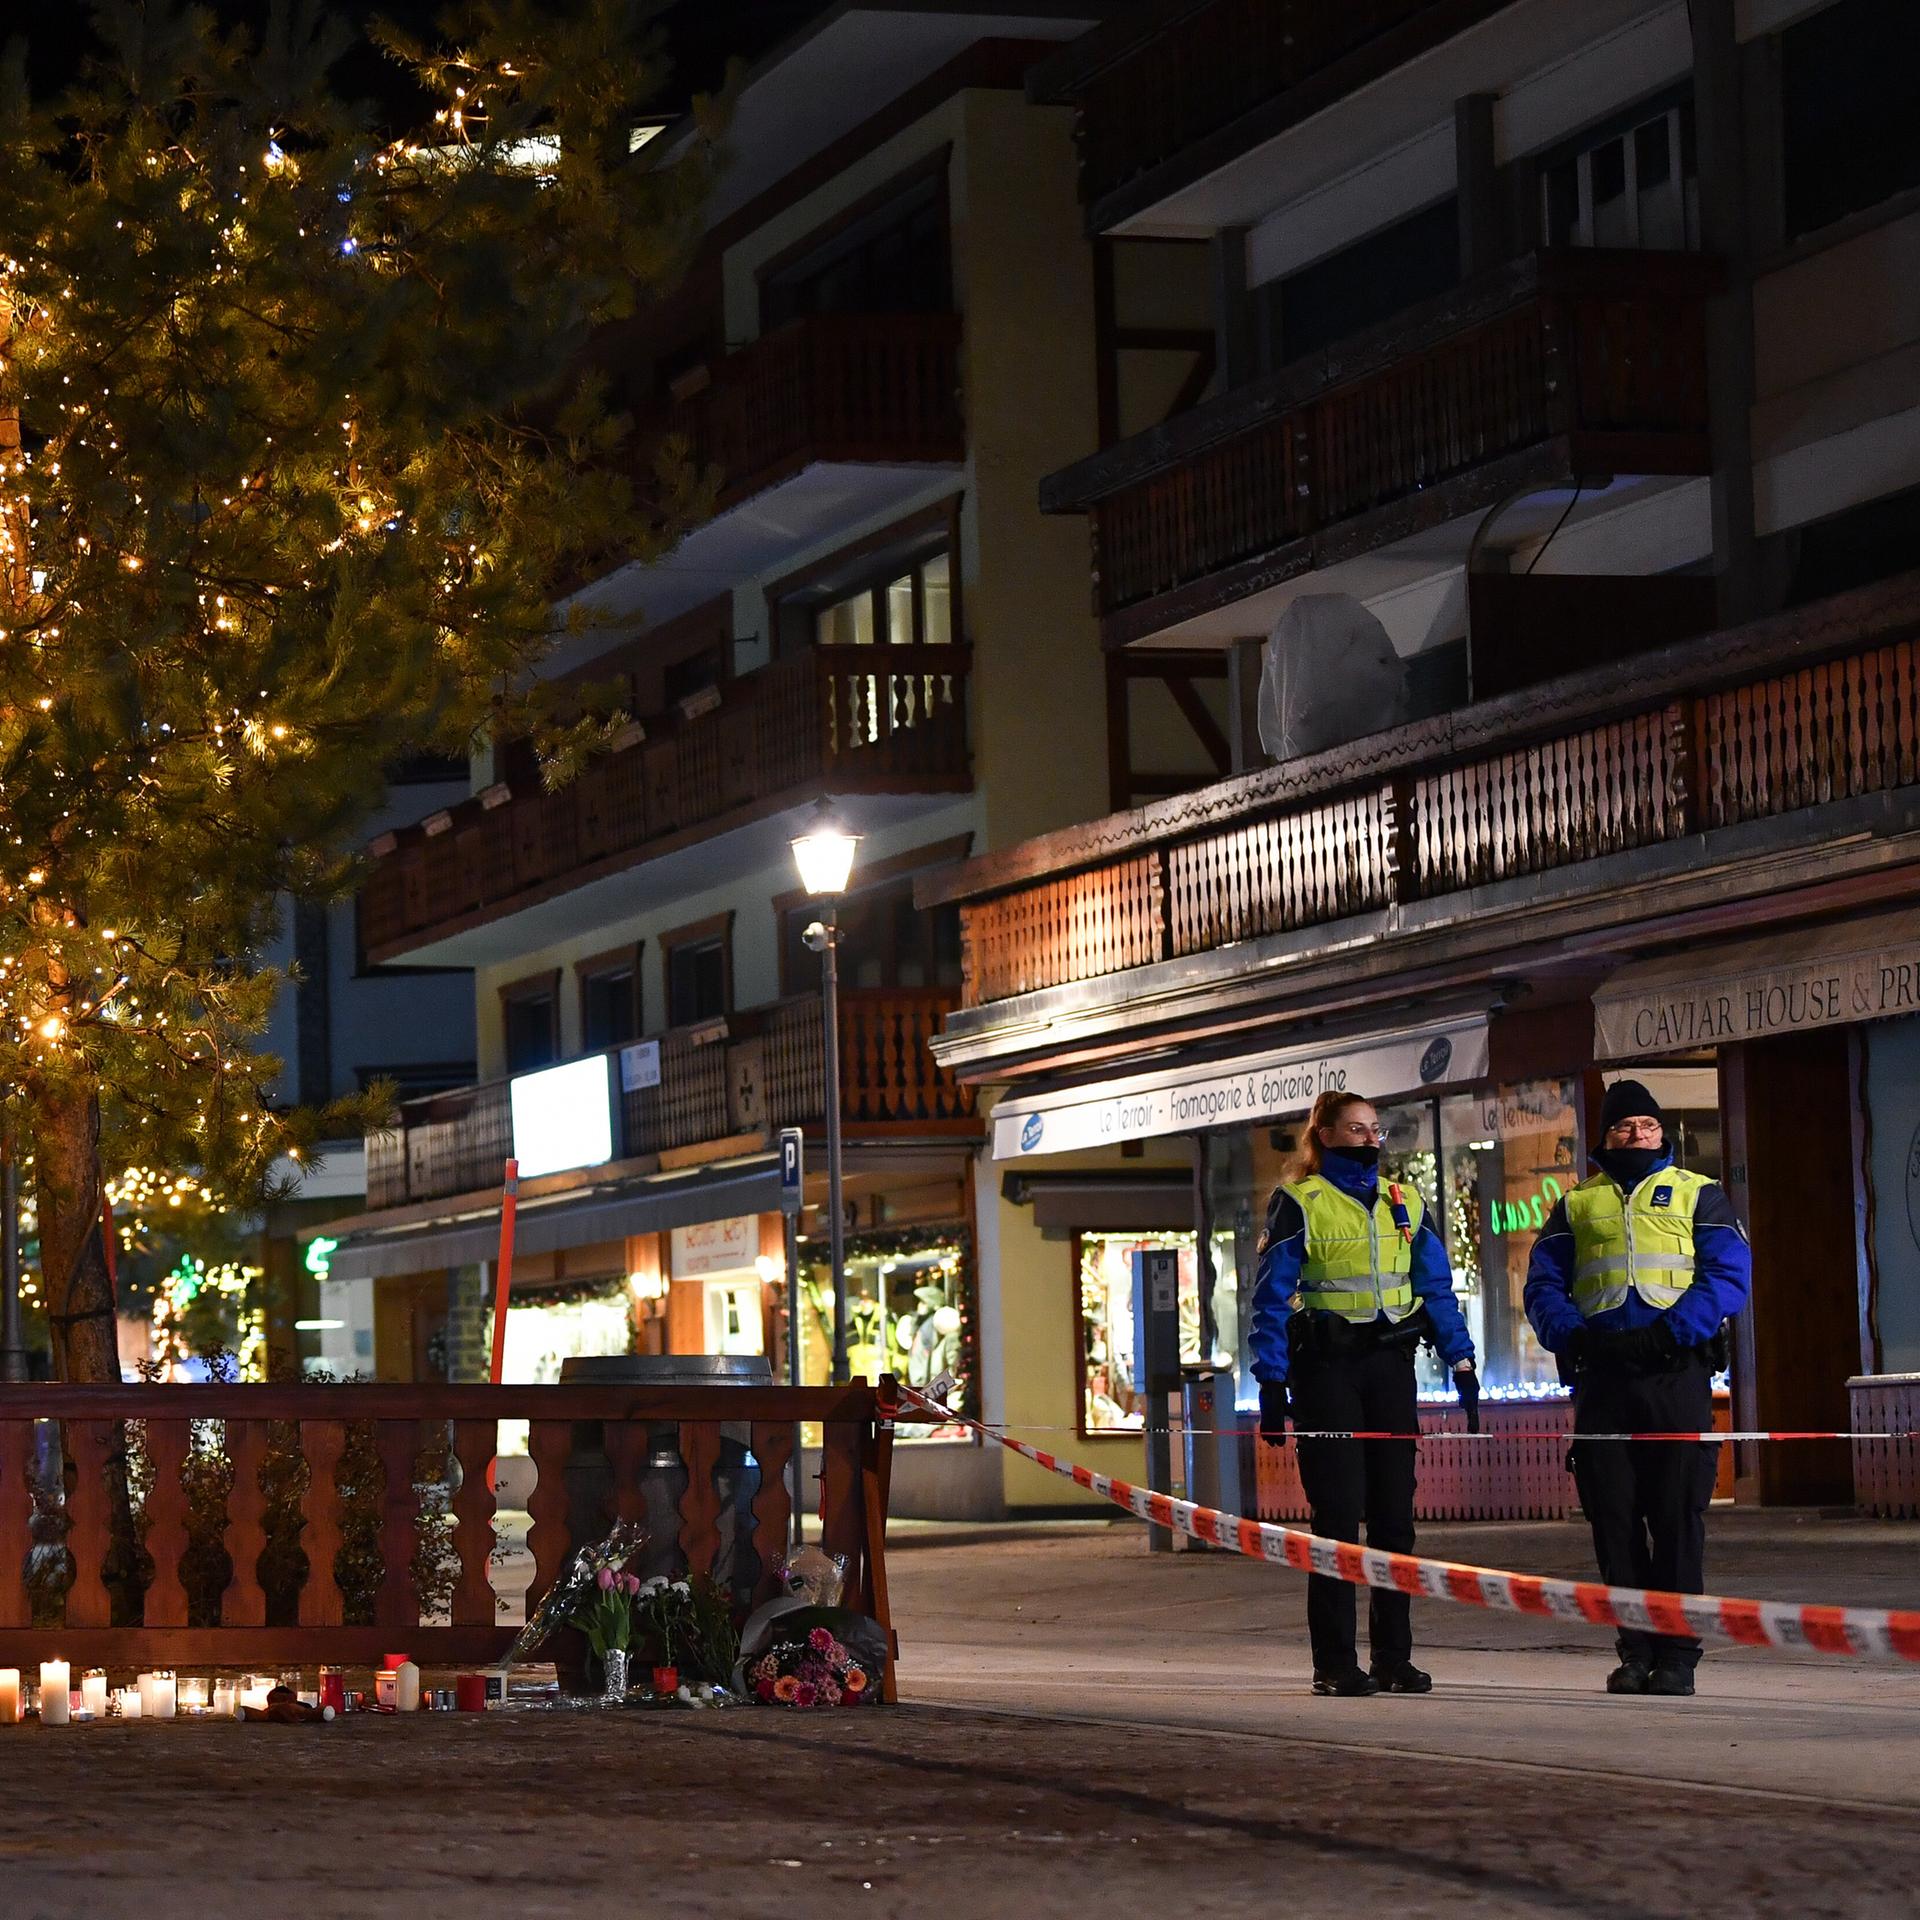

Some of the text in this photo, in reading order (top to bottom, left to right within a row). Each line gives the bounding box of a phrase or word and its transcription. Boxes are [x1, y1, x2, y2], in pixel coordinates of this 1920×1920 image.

[1634, 996, 1734, 1048] CAVIAR
[1745, 977, 1841, 1031] HOUSE
[1851, 972, 1872, 1014] &
[1100, 1104, 1112, 1133] Le
[1116, 1096, 1153, 1131] Terroir
[1246, 1076, 1256, 1107] &
[1261, 1065, 1313, 1112] épicerie
[785, 1142, 795, 1181] P
